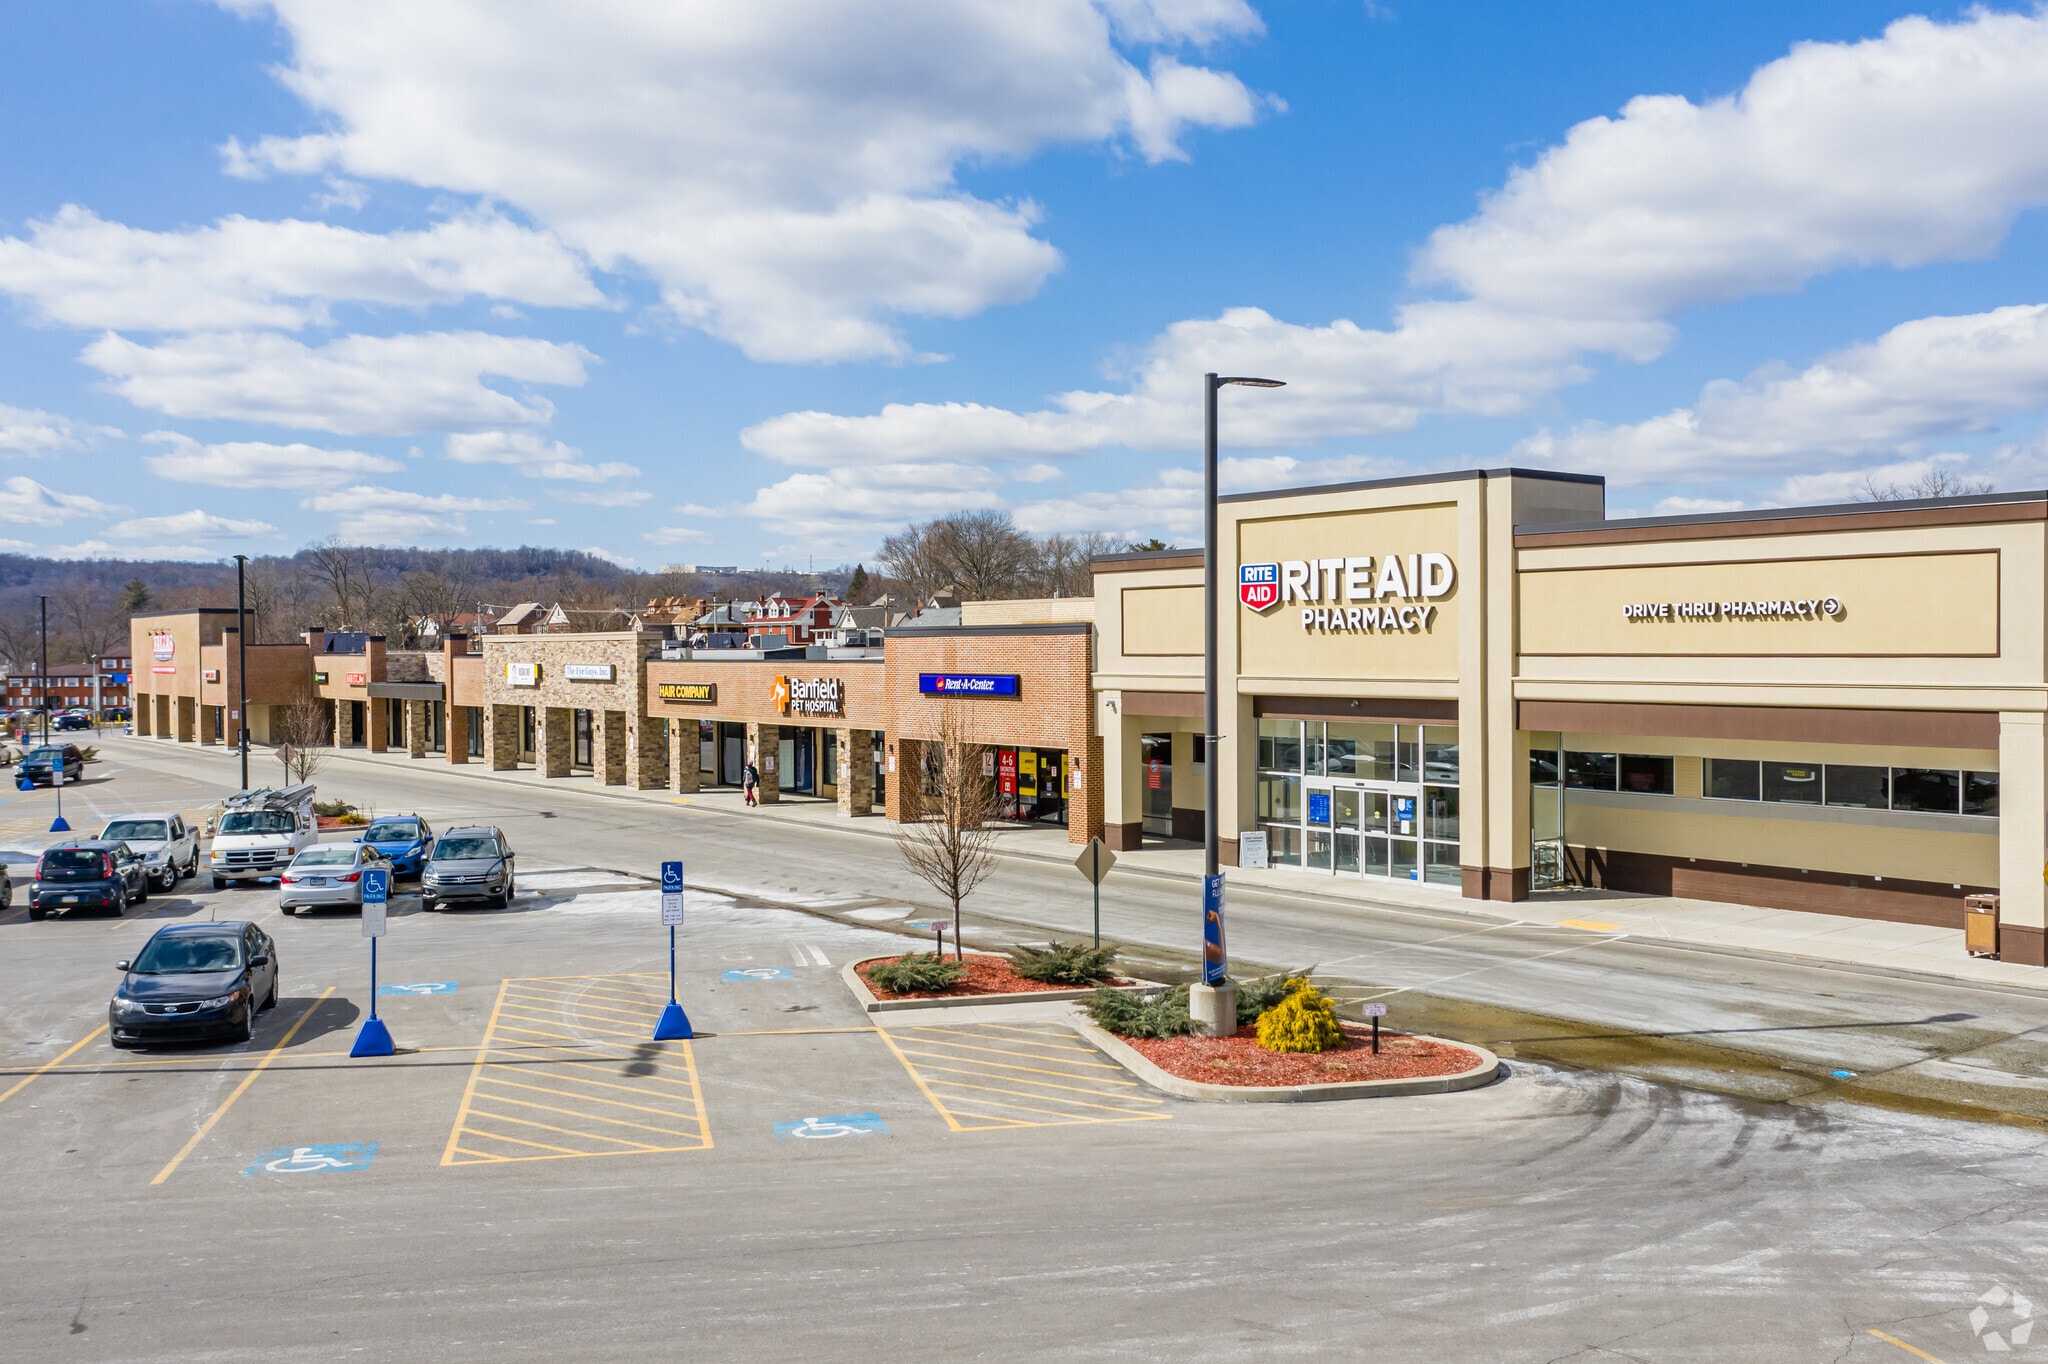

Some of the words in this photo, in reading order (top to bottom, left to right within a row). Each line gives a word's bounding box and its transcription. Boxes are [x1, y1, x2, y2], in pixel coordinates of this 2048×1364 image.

[1245, 566, 1273, 582] RITE
[1282, 556, 1372, 602] RITE
[1374, 552, 1456, 599] AID
[1246, 586, 1271, 602] AID
[1622, 603, 1669, 617] DRIVE
[1673, 602, 1716, 616] THRU
[1721, 600, 1819, 615] PHARMACY
[1301, 606, 1433, 630] PHARMACY
[659, 685, 675, 698] HAIR
[676, 685, 710, 699] COMPANY
[791, 678, 838, 699] Banfield
[791, 699, 804, 711] PET
[805, 700, 838, 713] HOSPITAL
[1002, 754, 1013, 766] 4-6
[1211, 878, 1220, 888] GET
